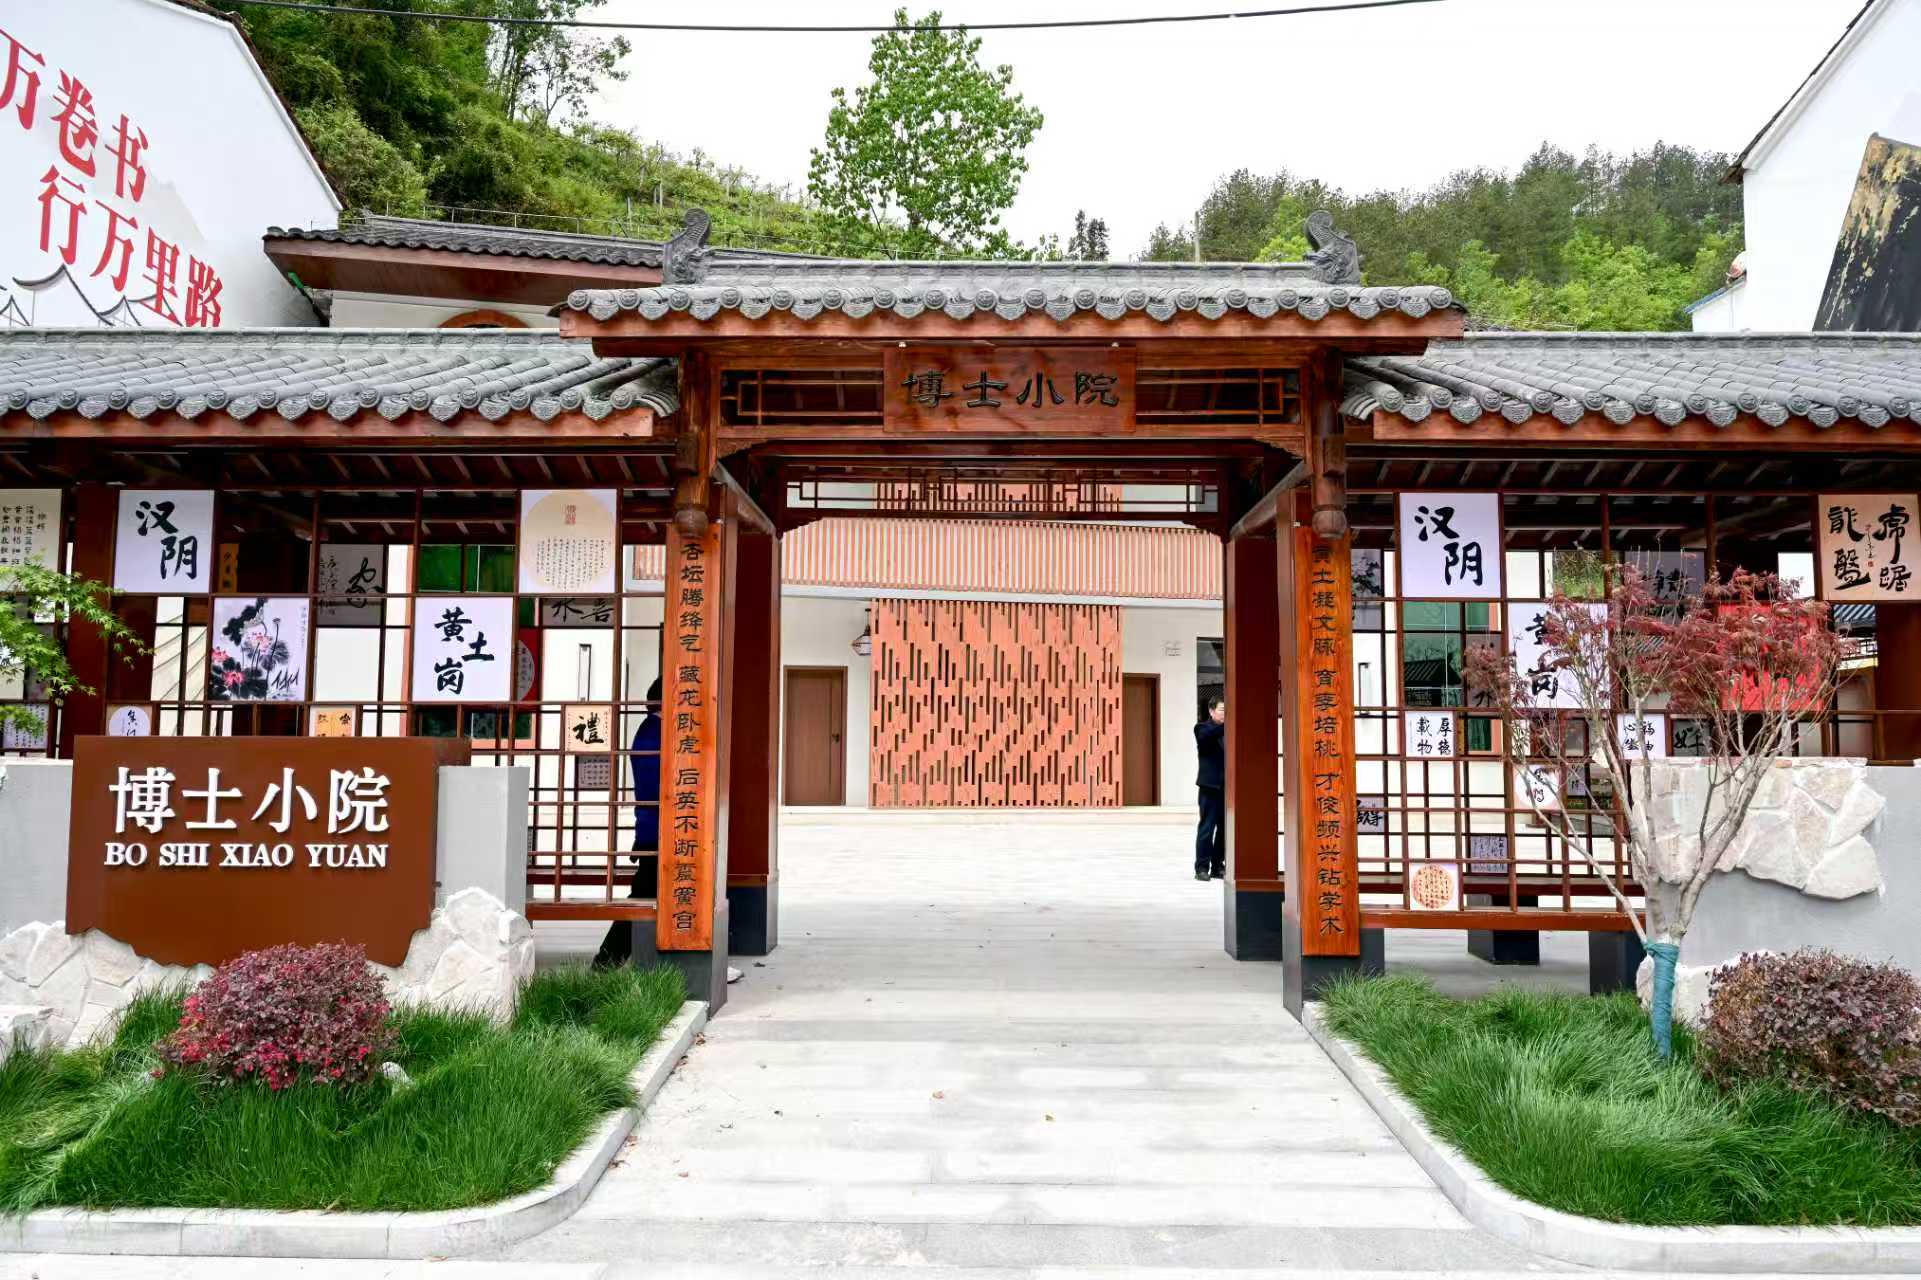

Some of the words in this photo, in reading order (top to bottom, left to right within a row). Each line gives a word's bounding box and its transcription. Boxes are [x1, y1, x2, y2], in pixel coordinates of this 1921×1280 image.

[38, 165, 224, 328] 行万里路
[901, 369, 1120, 409] 博士小院
[136, 501, 198, 580] 汉阴
[1414, 505, 1483, 587] 汉阴
[434, 606, 495, 695] 黄土岗
[109, 766, 392, 835] 博士小院
[104, 843, 148, 867] BO
[159, 843, 210, 868] SHI
[219, 843, 294, 868] XIAO
[306, 843, 389, 868] YUAN
